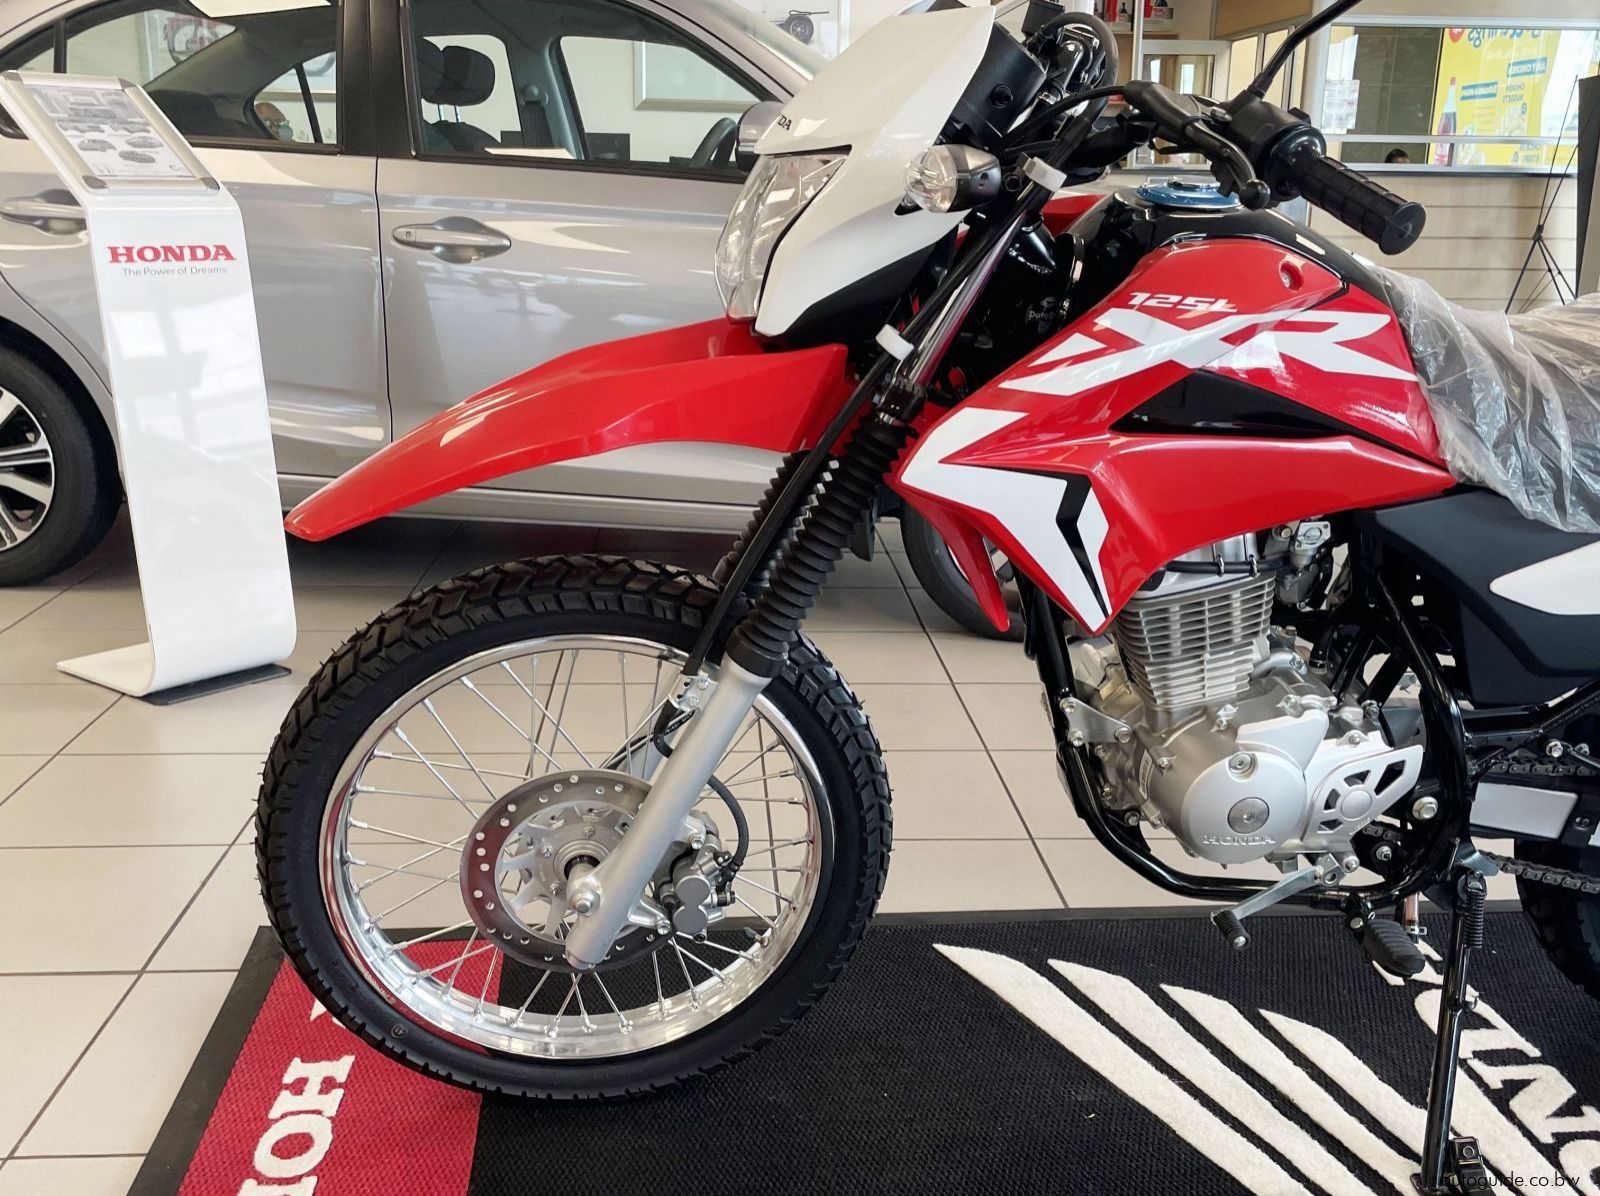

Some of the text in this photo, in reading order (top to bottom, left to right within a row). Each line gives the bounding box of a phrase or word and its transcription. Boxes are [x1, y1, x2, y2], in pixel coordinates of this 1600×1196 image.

[107, 244, 237, 263] HONDA
[122, 266, 228, 276] The Power of Dreams
[998, 307, 1418, 396] XR
[1202, 834, 1277, 846] HONDA
